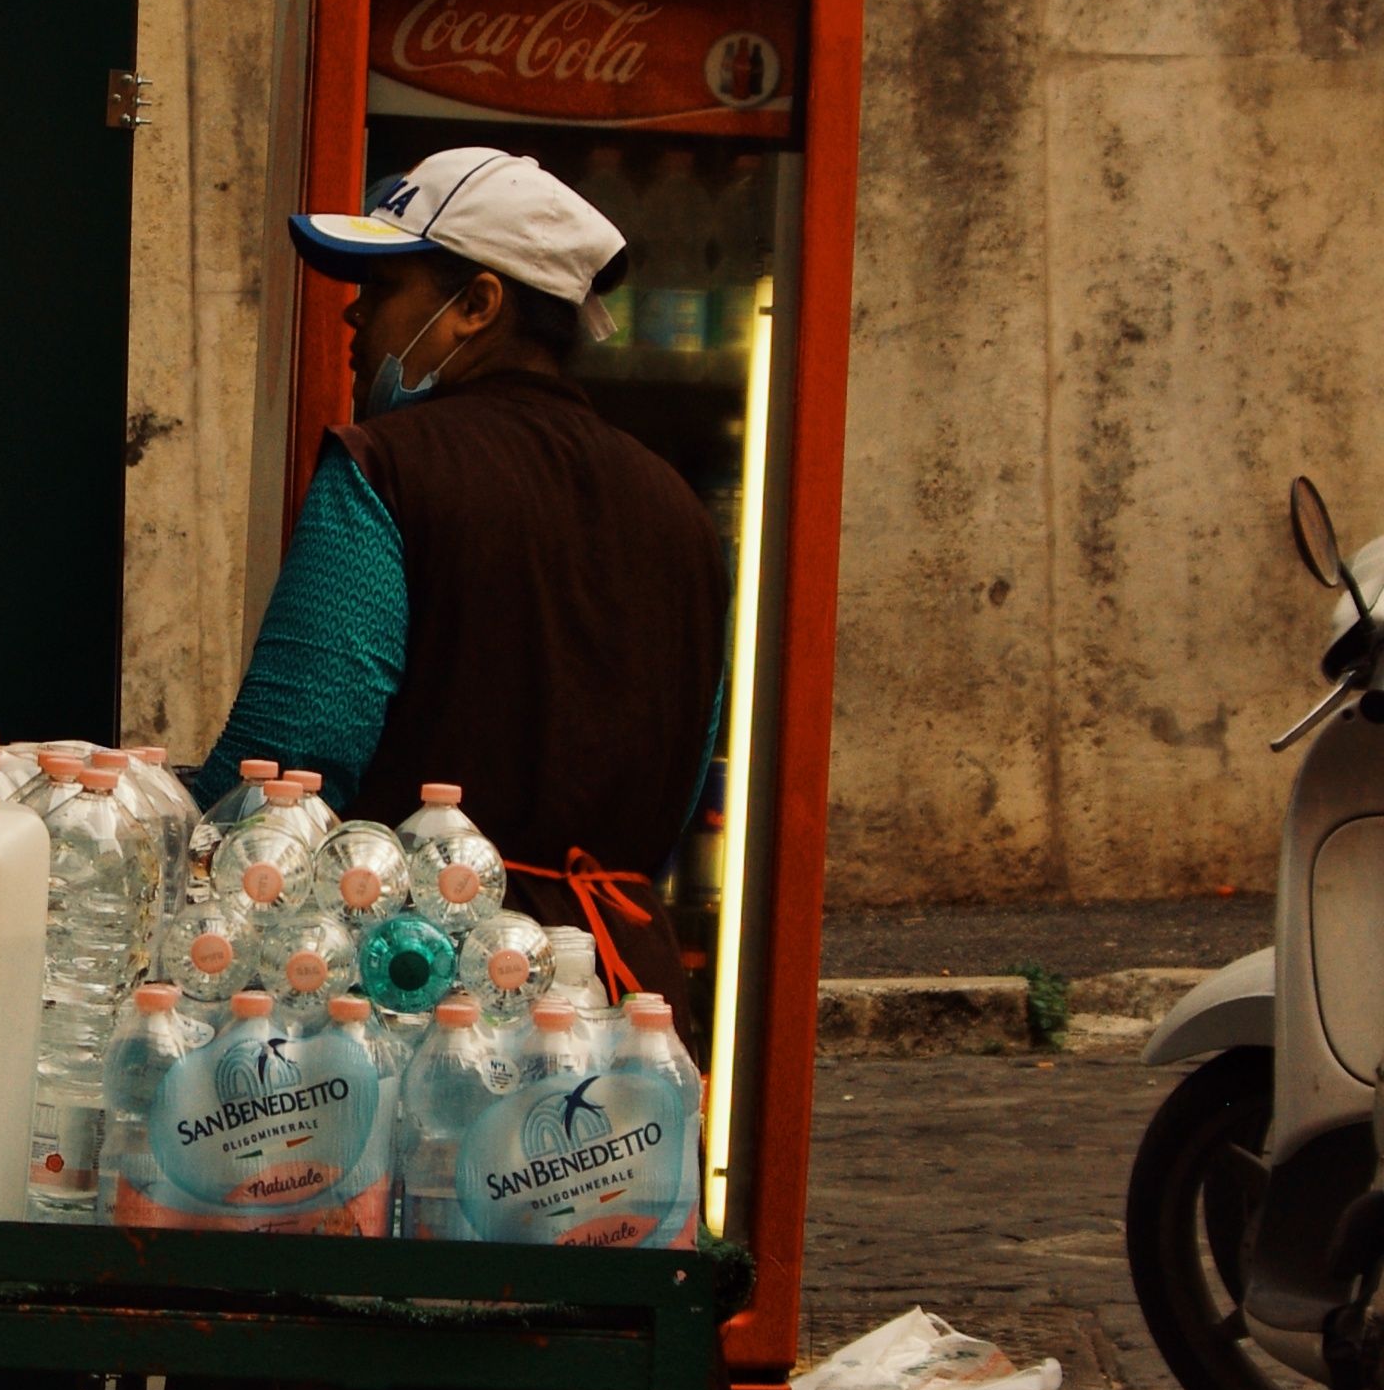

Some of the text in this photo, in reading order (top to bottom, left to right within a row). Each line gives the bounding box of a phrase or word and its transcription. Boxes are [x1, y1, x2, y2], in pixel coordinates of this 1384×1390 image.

[222, 1119, 319, 1153] OLIGOMINERALE
[248, 1167, 324, 1198] Naturale
[531, 1169, 635, 1210] OLIGOMINERALE
